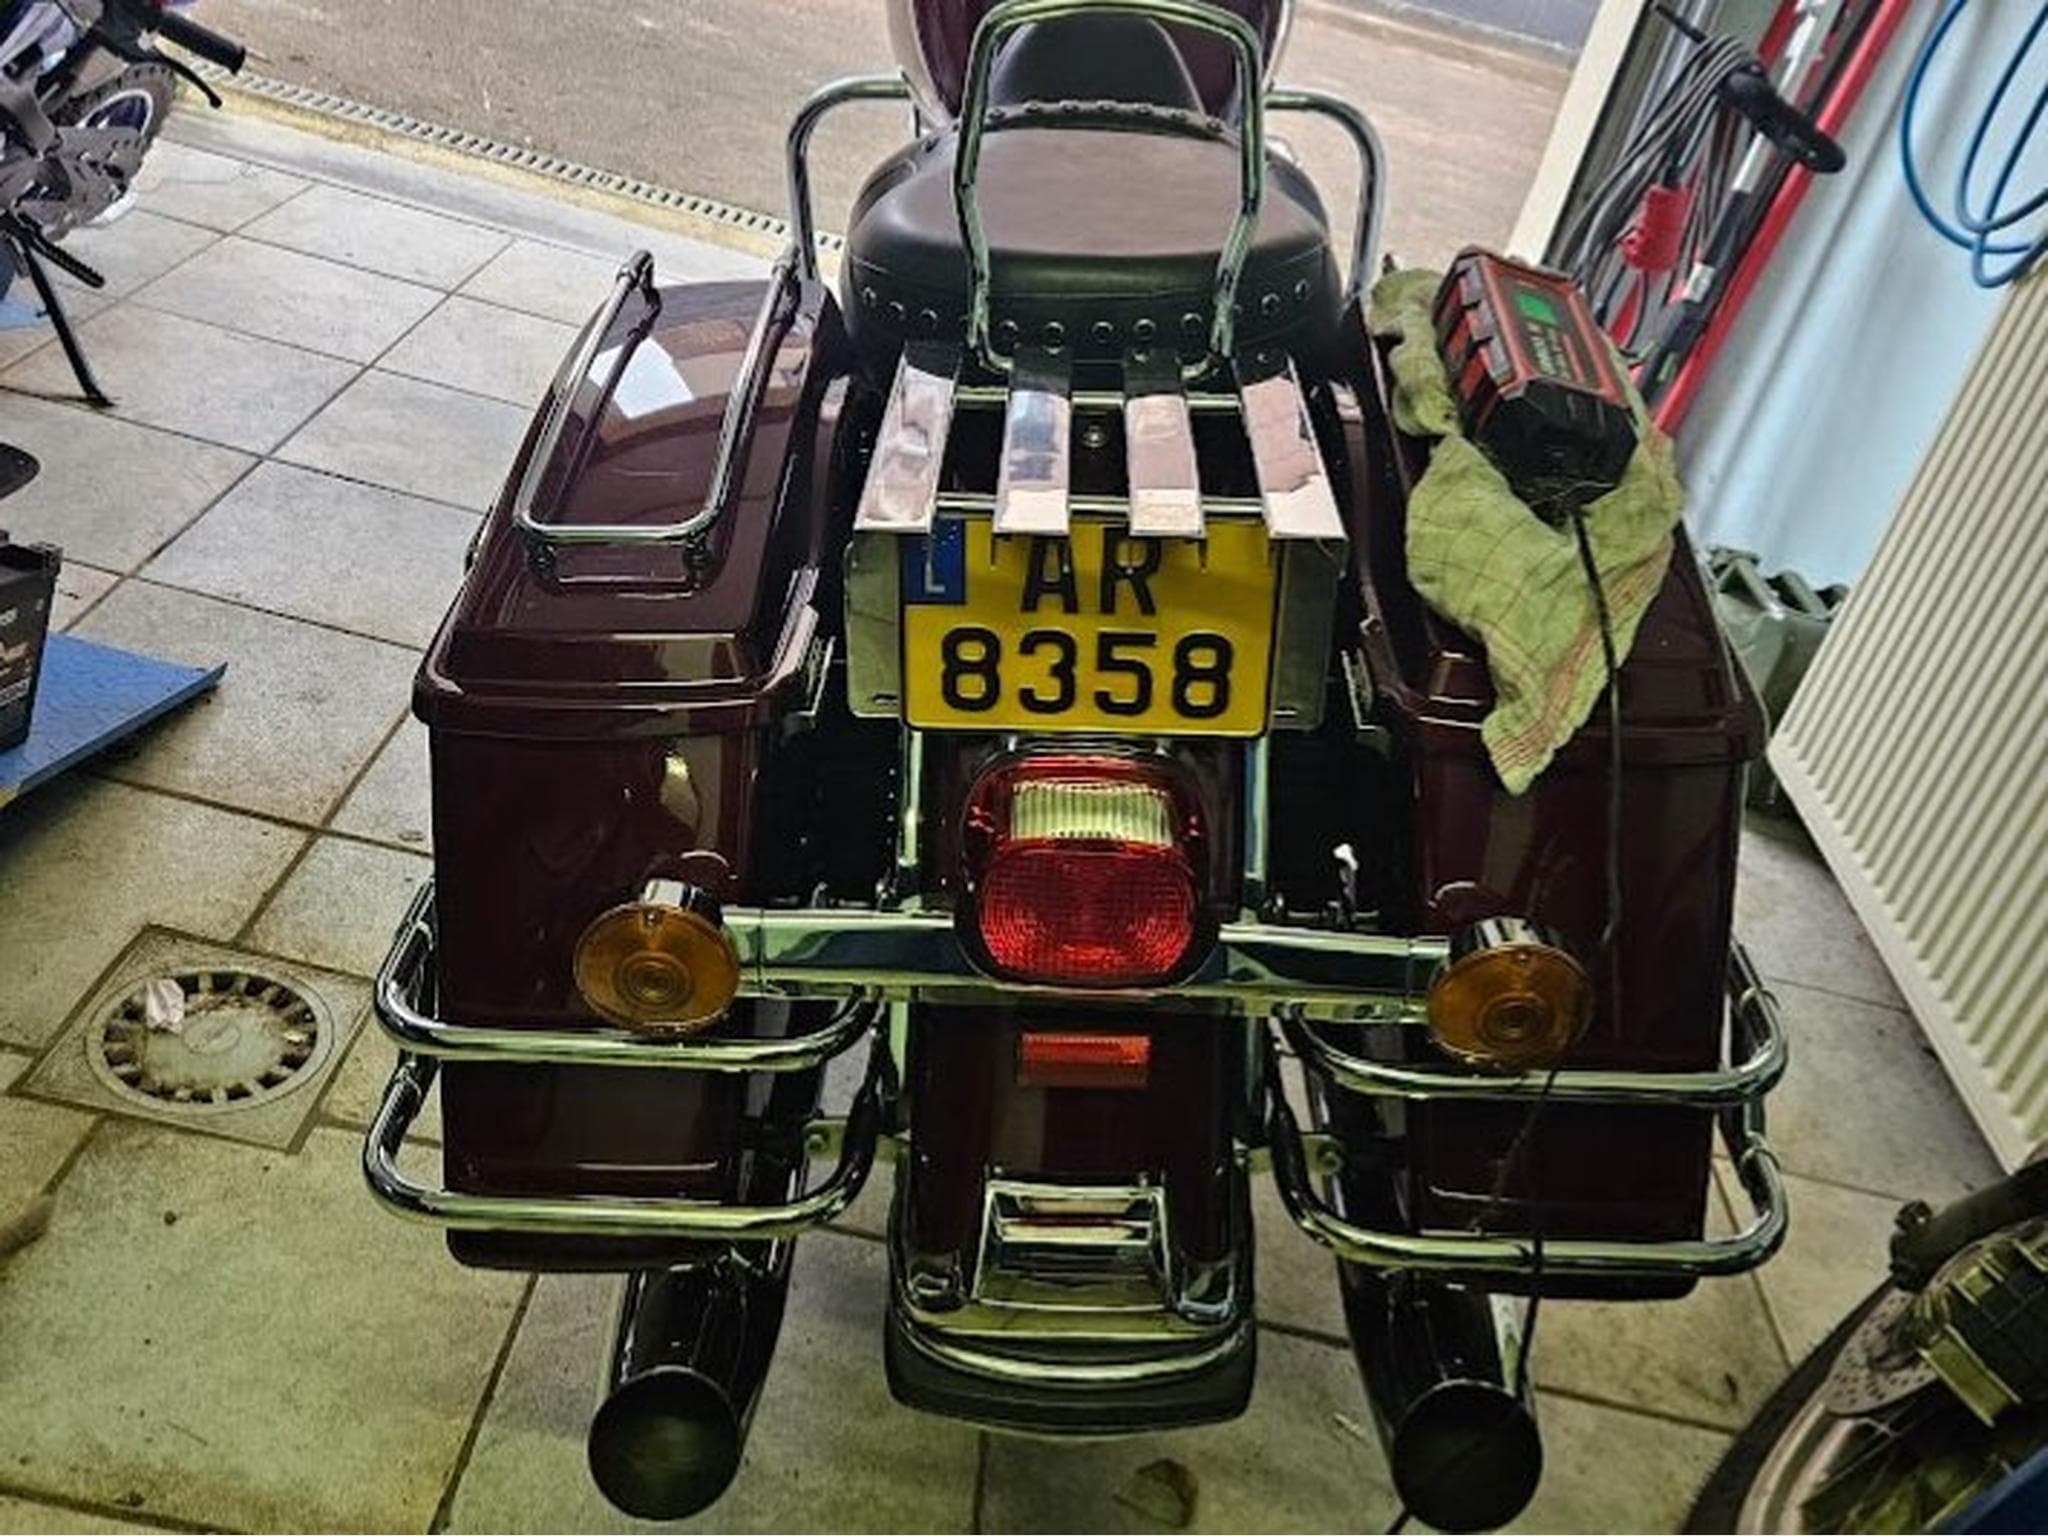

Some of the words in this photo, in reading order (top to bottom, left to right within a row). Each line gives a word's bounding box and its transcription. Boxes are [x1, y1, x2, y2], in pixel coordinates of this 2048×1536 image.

[925, 558, 946, 593] L
[1021, 527, 1160, 616] AR
[941, 627, 1233, 719] 8358
